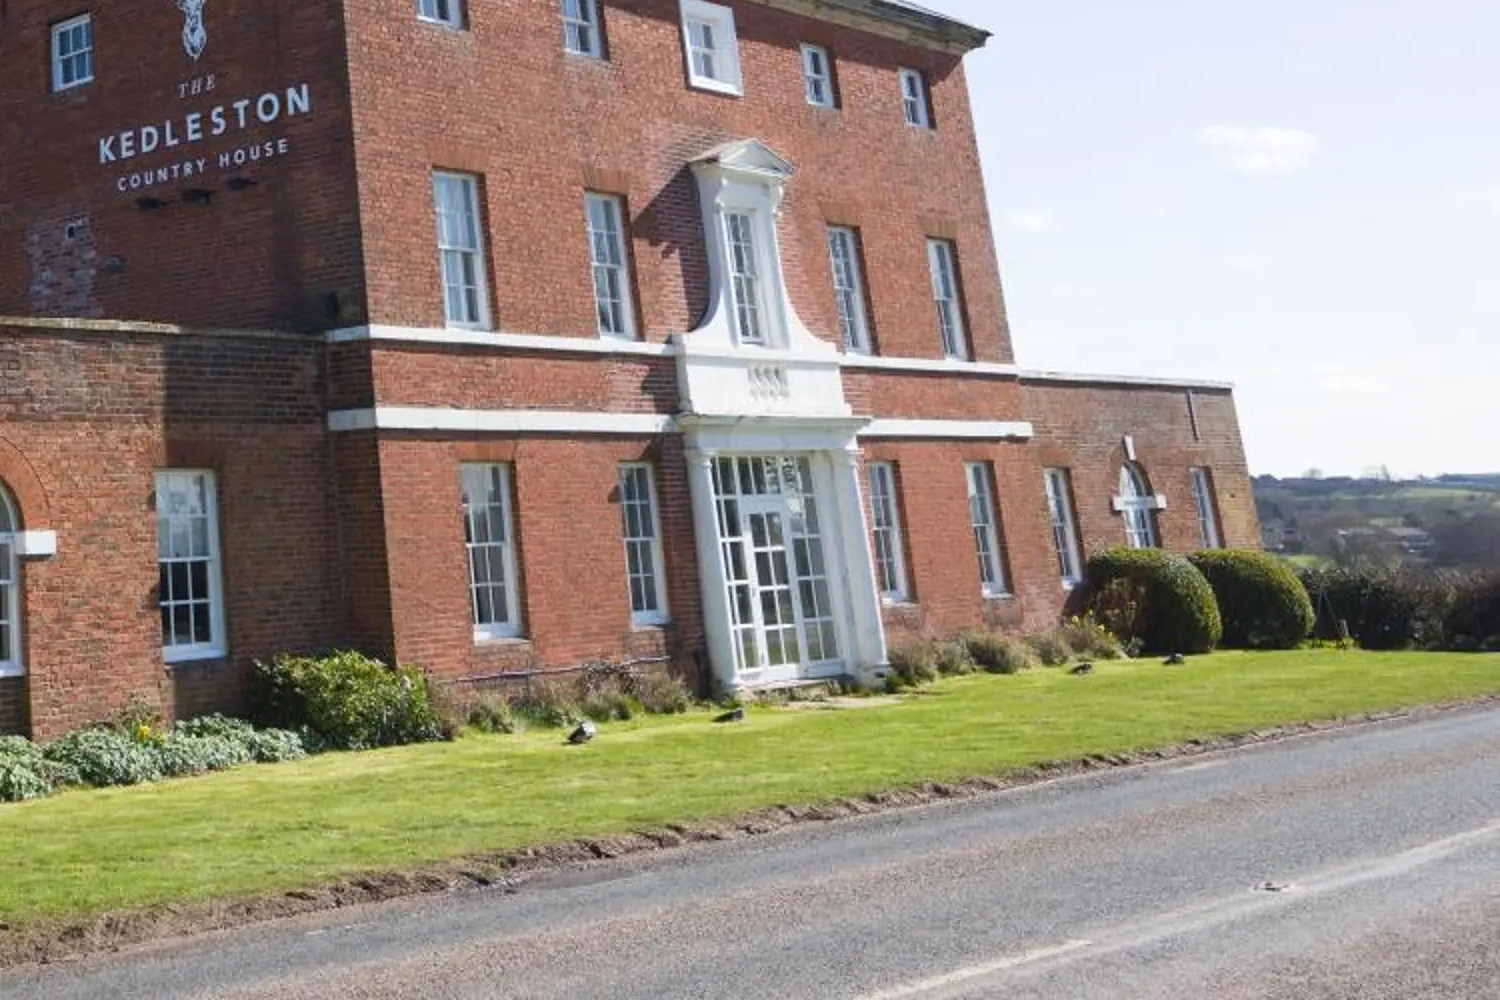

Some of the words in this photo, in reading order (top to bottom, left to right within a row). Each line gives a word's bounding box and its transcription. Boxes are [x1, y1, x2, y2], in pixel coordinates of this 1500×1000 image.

[178, 74, 216, 98] THE
[99, 84, 310, 163] KEDLESTON
[117, 158, 206, 191] COUNTRY
[219, 138, 288, 168] HOUSE
